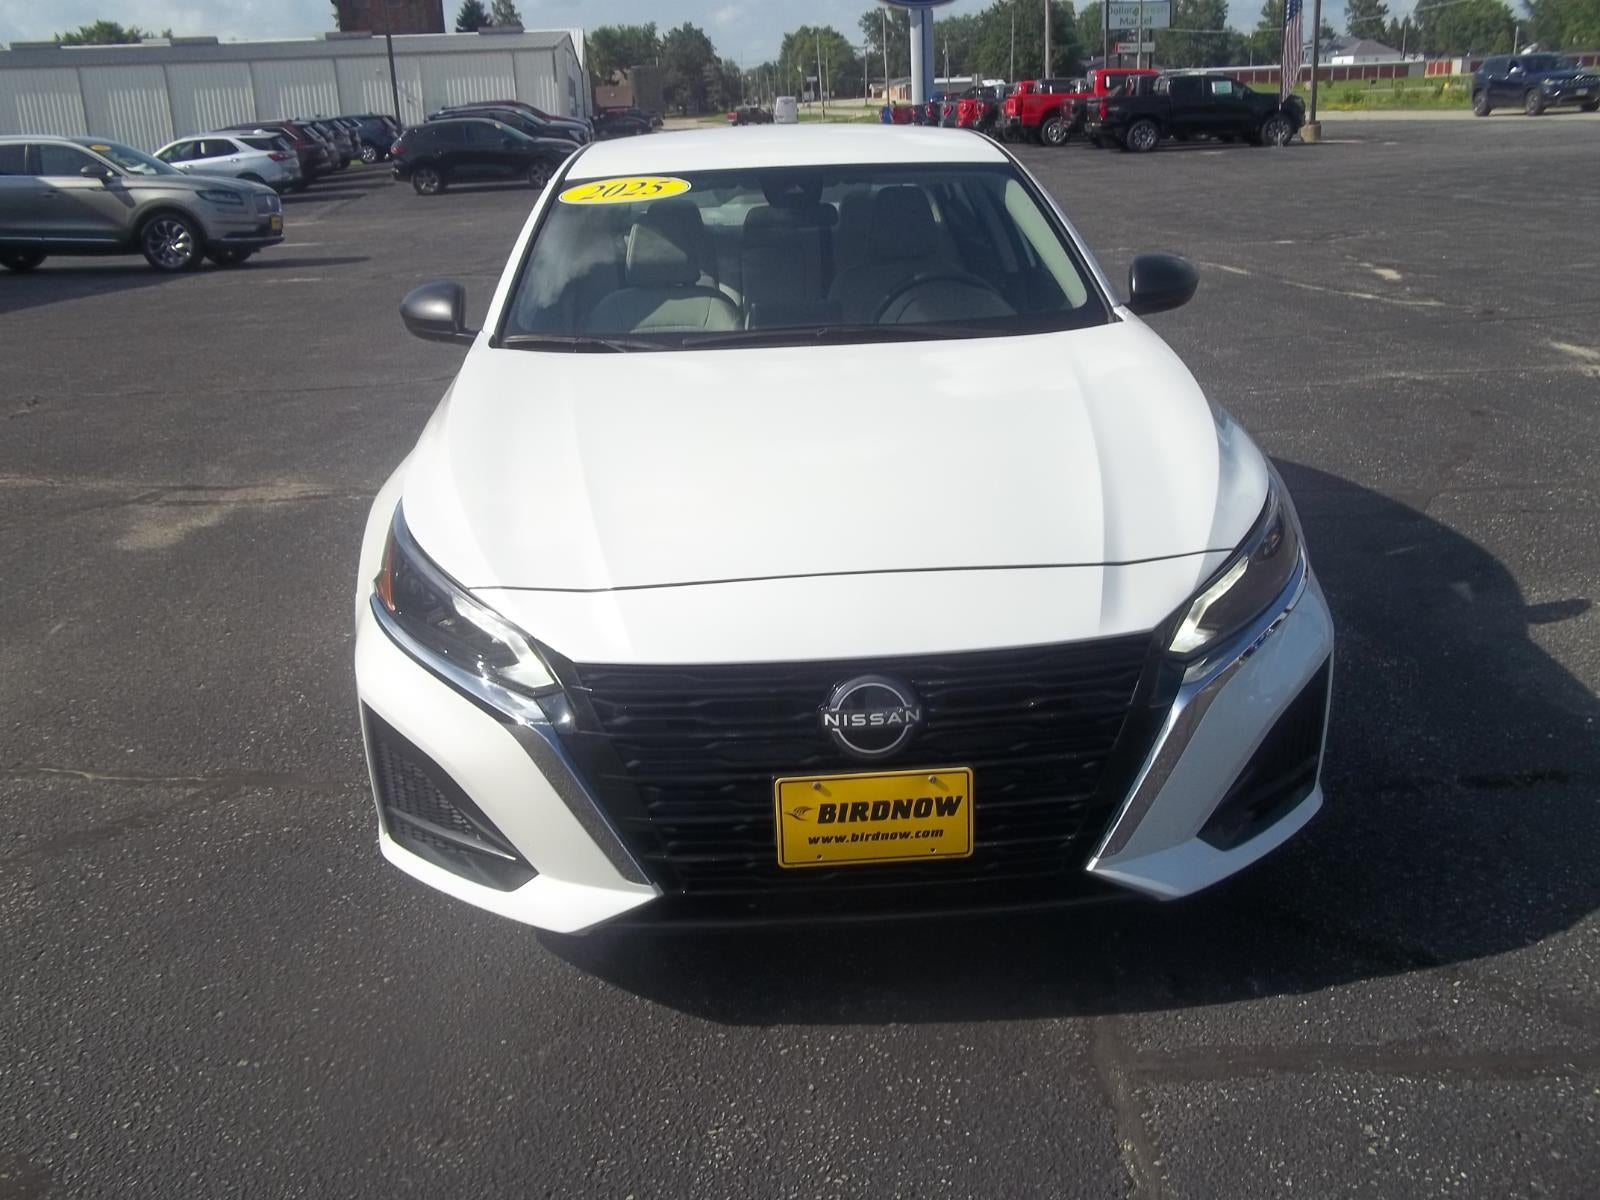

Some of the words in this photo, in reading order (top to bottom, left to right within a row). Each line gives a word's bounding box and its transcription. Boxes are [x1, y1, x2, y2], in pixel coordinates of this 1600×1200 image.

[1142, 5, 1168, 15] resh
[1119, 16, 1152, 26] Maret
[577, 180, 672, 200] 2025
[824, 709, 920, 727] NISSAN
[817, 795, 963, 825] BIRDNOW
[808, 829, 944, 845] www.birdnow.com
